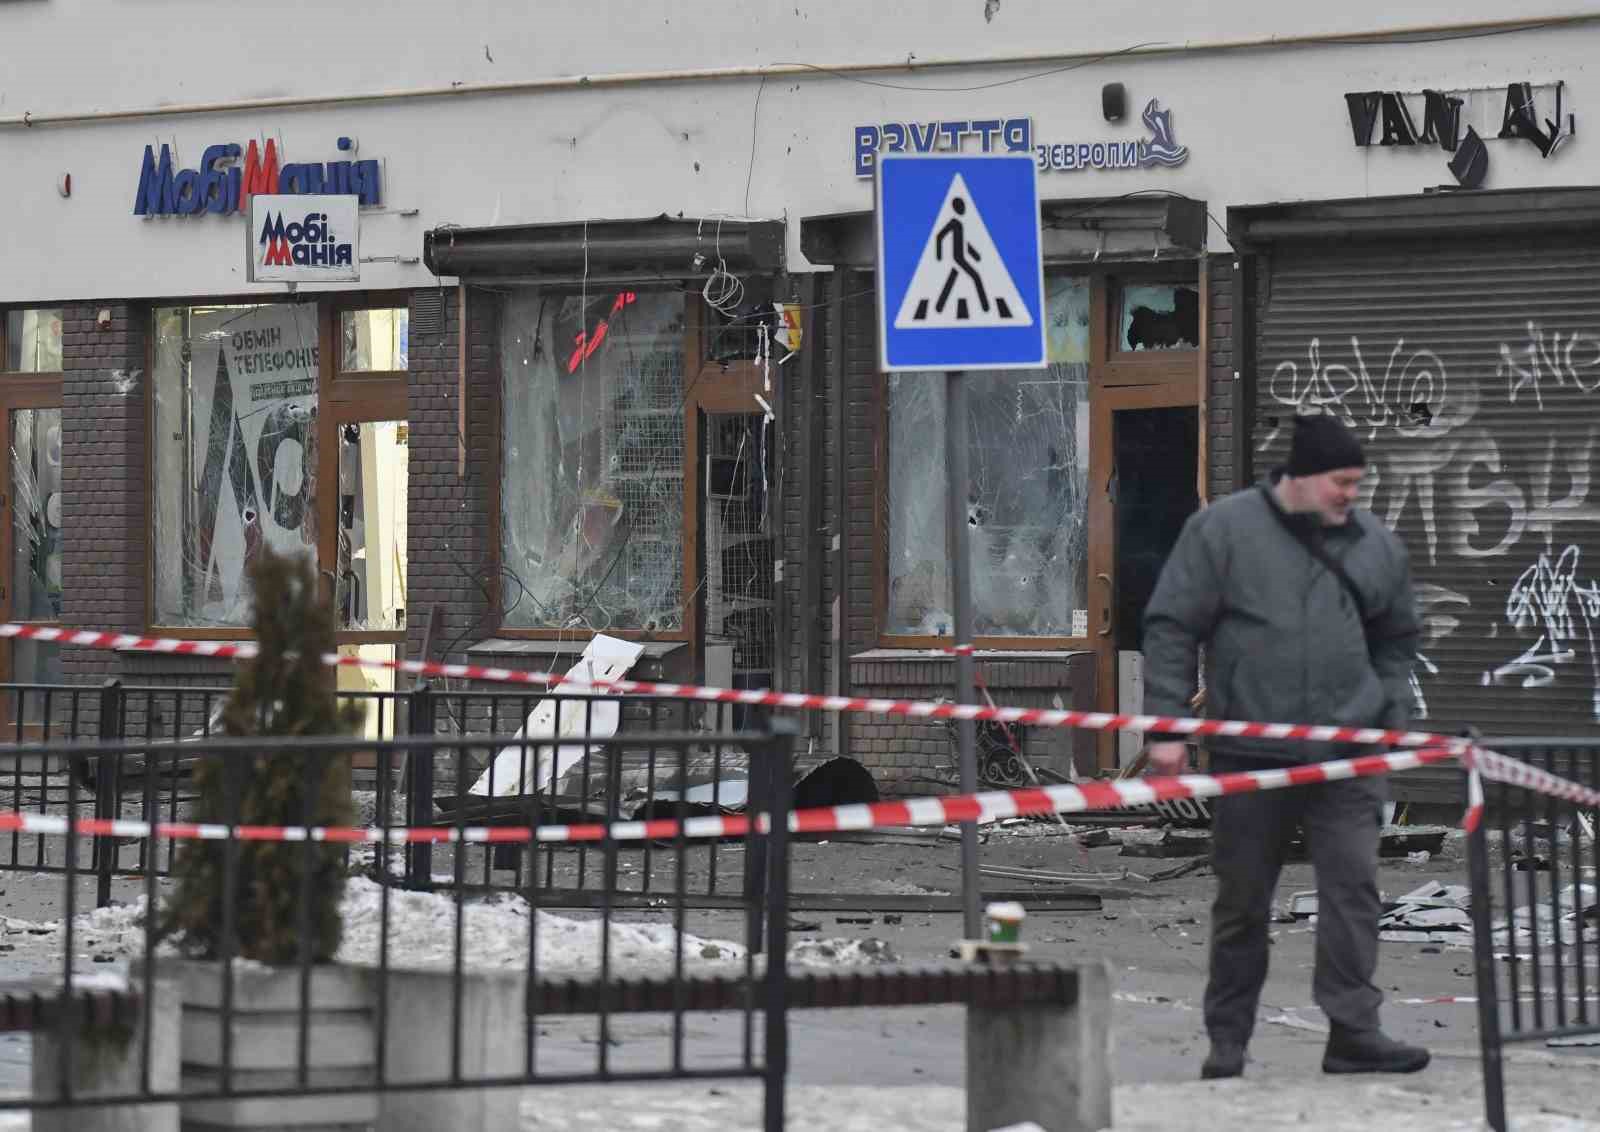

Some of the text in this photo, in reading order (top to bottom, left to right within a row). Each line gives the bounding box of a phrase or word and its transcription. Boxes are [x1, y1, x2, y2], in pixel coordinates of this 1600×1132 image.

[854, 117, 1031, 177] ВЗУТТЯ
[260, 210, 328, 245] Мобі
[264, 235, 353, 267] Манія
[231, 327, 281, 351] ОБМІН
